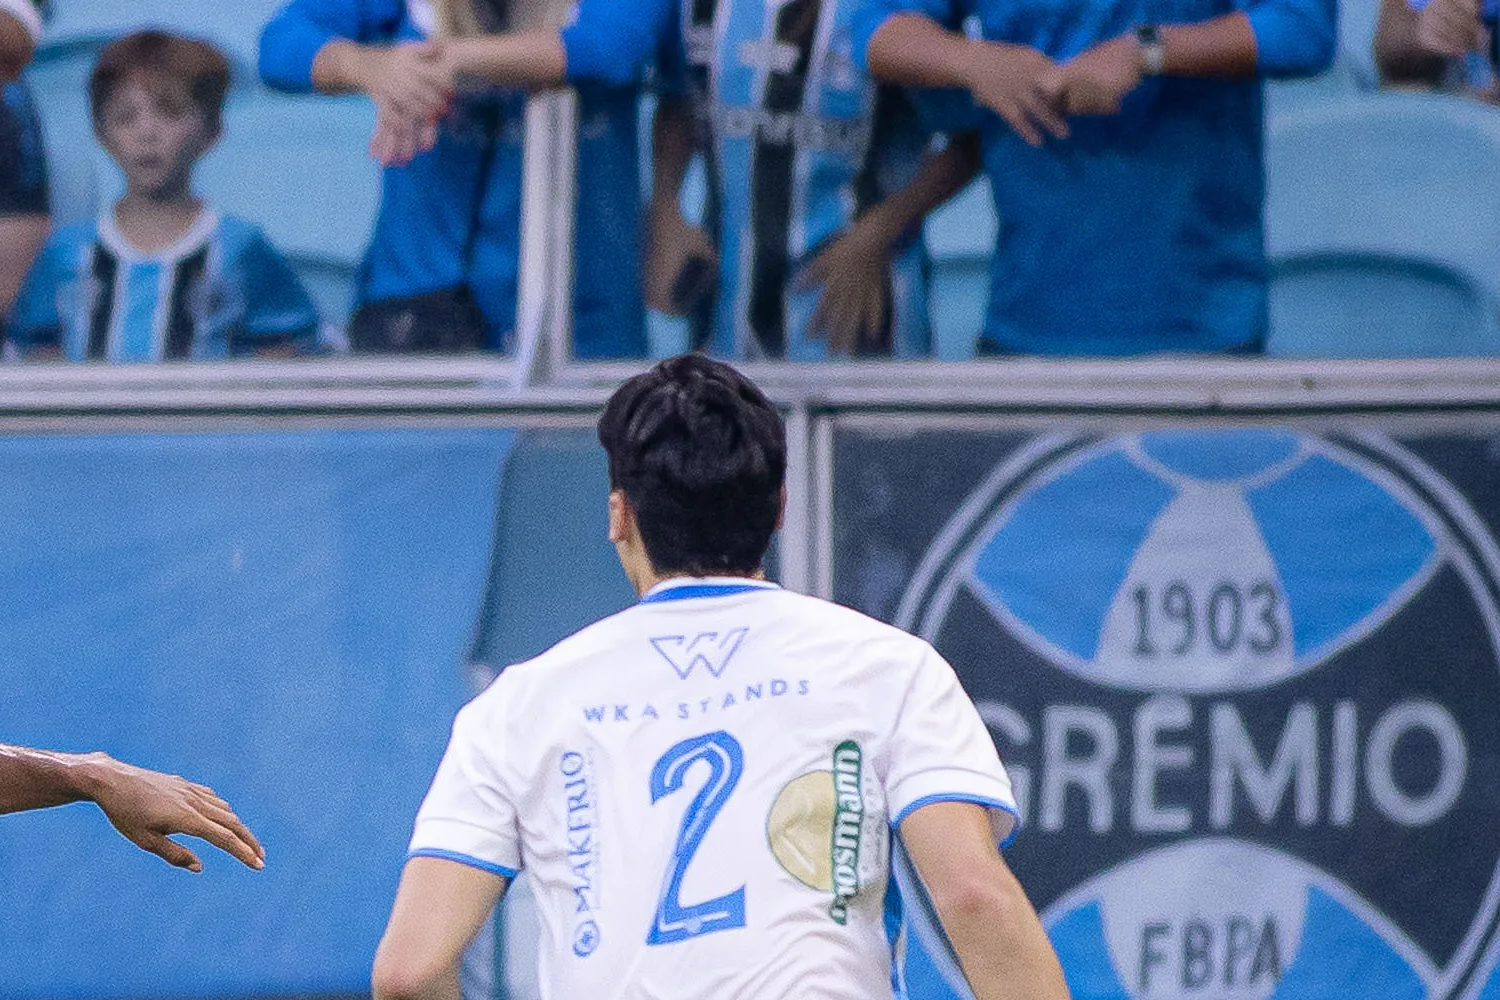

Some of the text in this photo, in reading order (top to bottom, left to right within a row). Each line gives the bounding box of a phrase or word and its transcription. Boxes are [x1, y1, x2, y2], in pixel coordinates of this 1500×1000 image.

[1130, 582, 1281, 657] 1903
[583, 678, 809, 722] WKA STANDS
[645, 730, 747, 946] 2
[1140, 912, 1282, 991] FBPA
